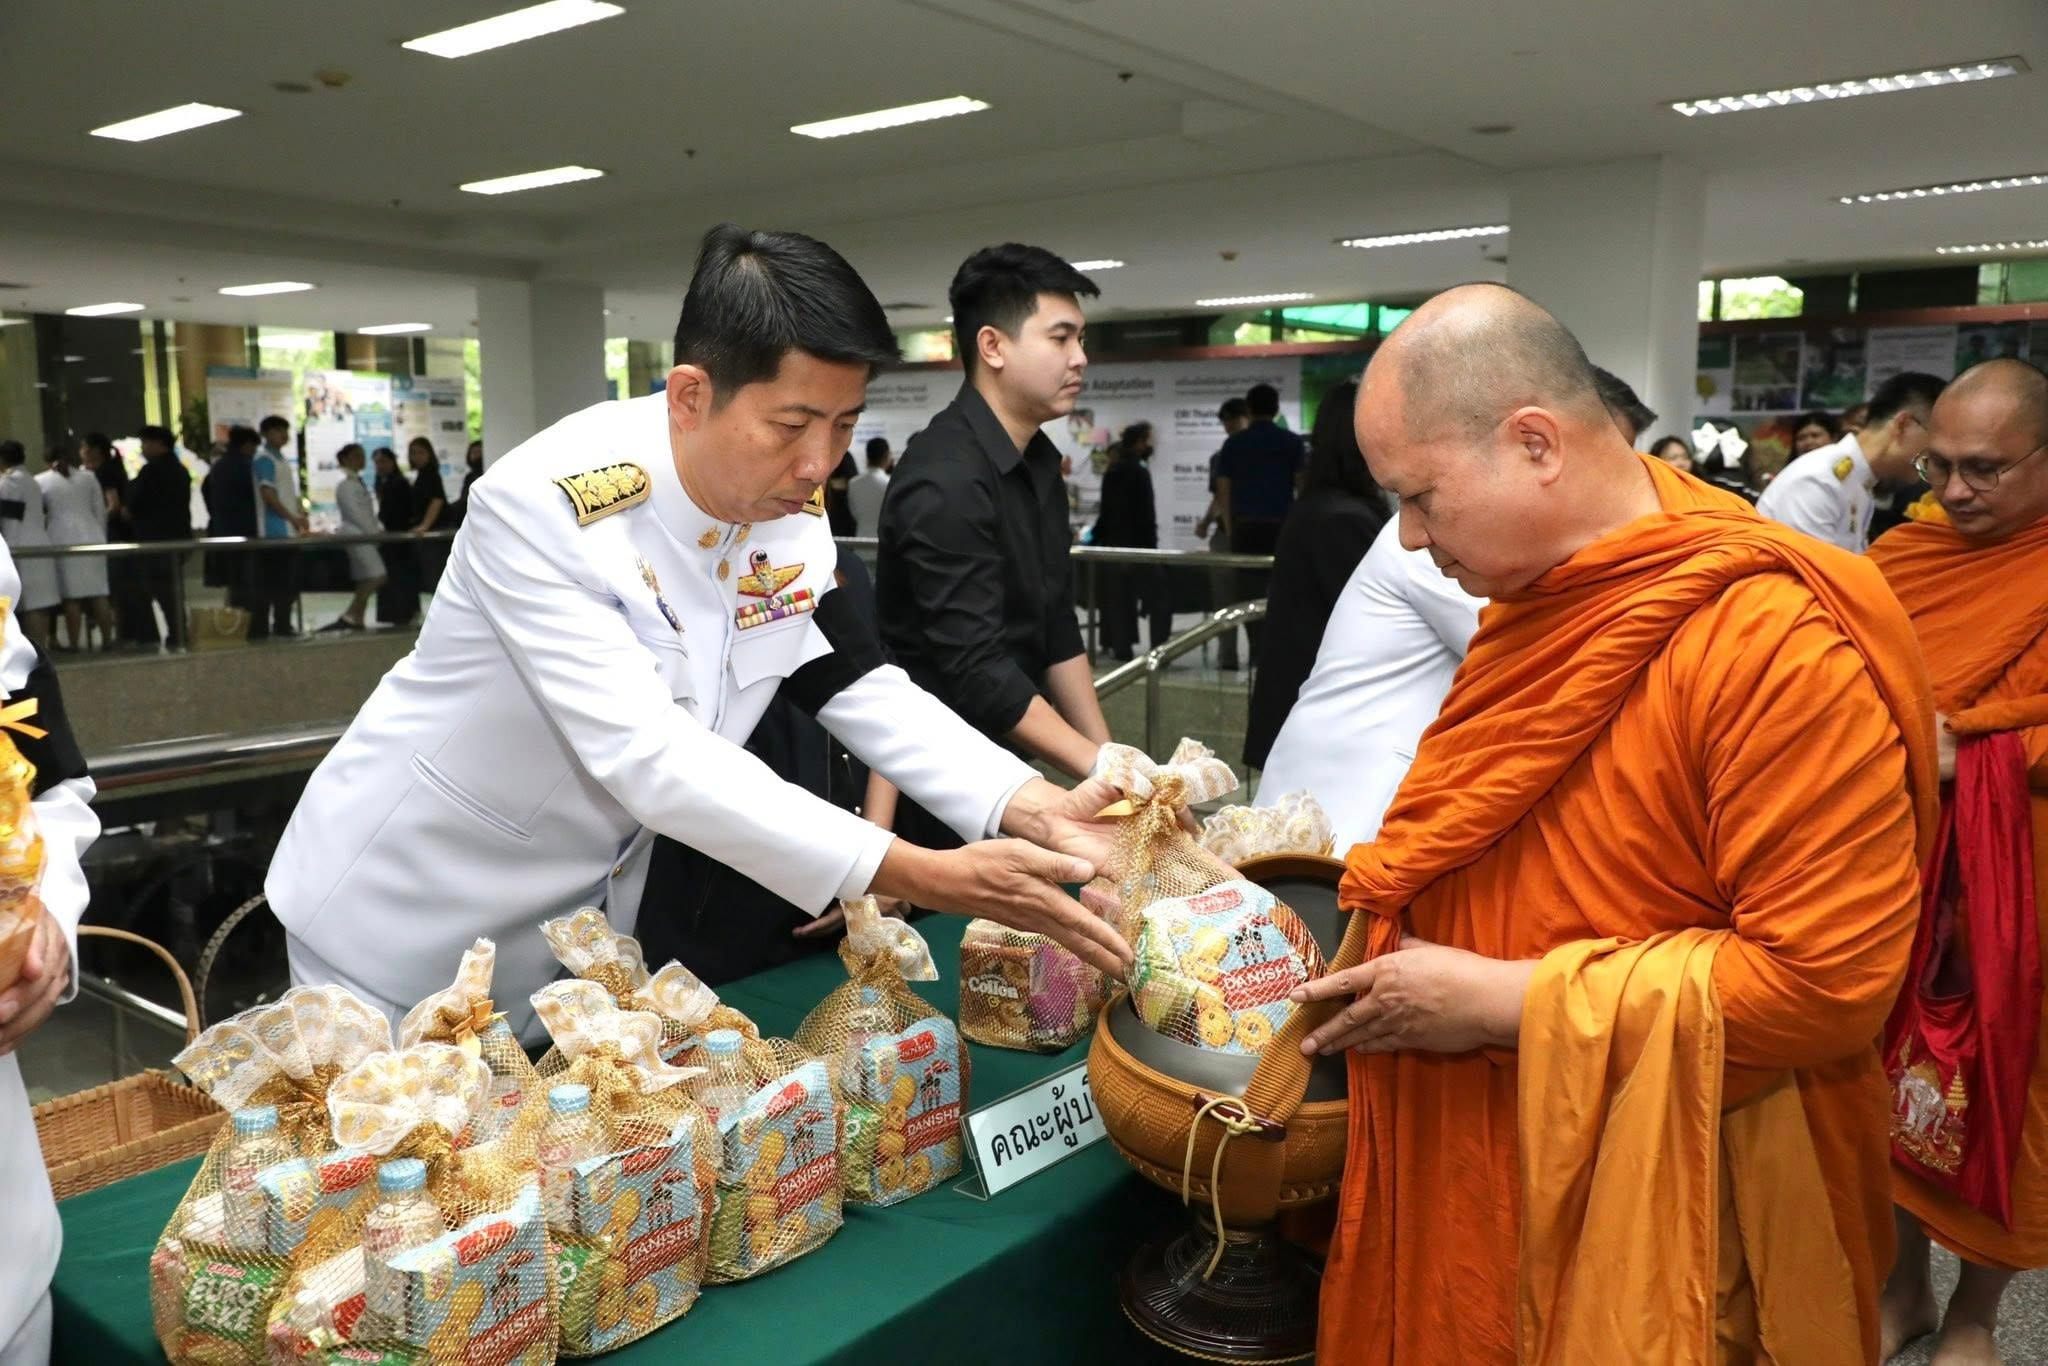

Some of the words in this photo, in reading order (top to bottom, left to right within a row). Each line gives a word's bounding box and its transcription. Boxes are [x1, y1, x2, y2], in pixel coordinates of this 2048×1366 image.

[1225, 965, 1287, 989] DANISH
[907, 1109, 953, 1136] DANISH
[991, 1073, 1094, 1167] คณะผู้บ
[779, 1160, 831, 1197] DANISH
[630, 1224, 687, 1261] DANISH
